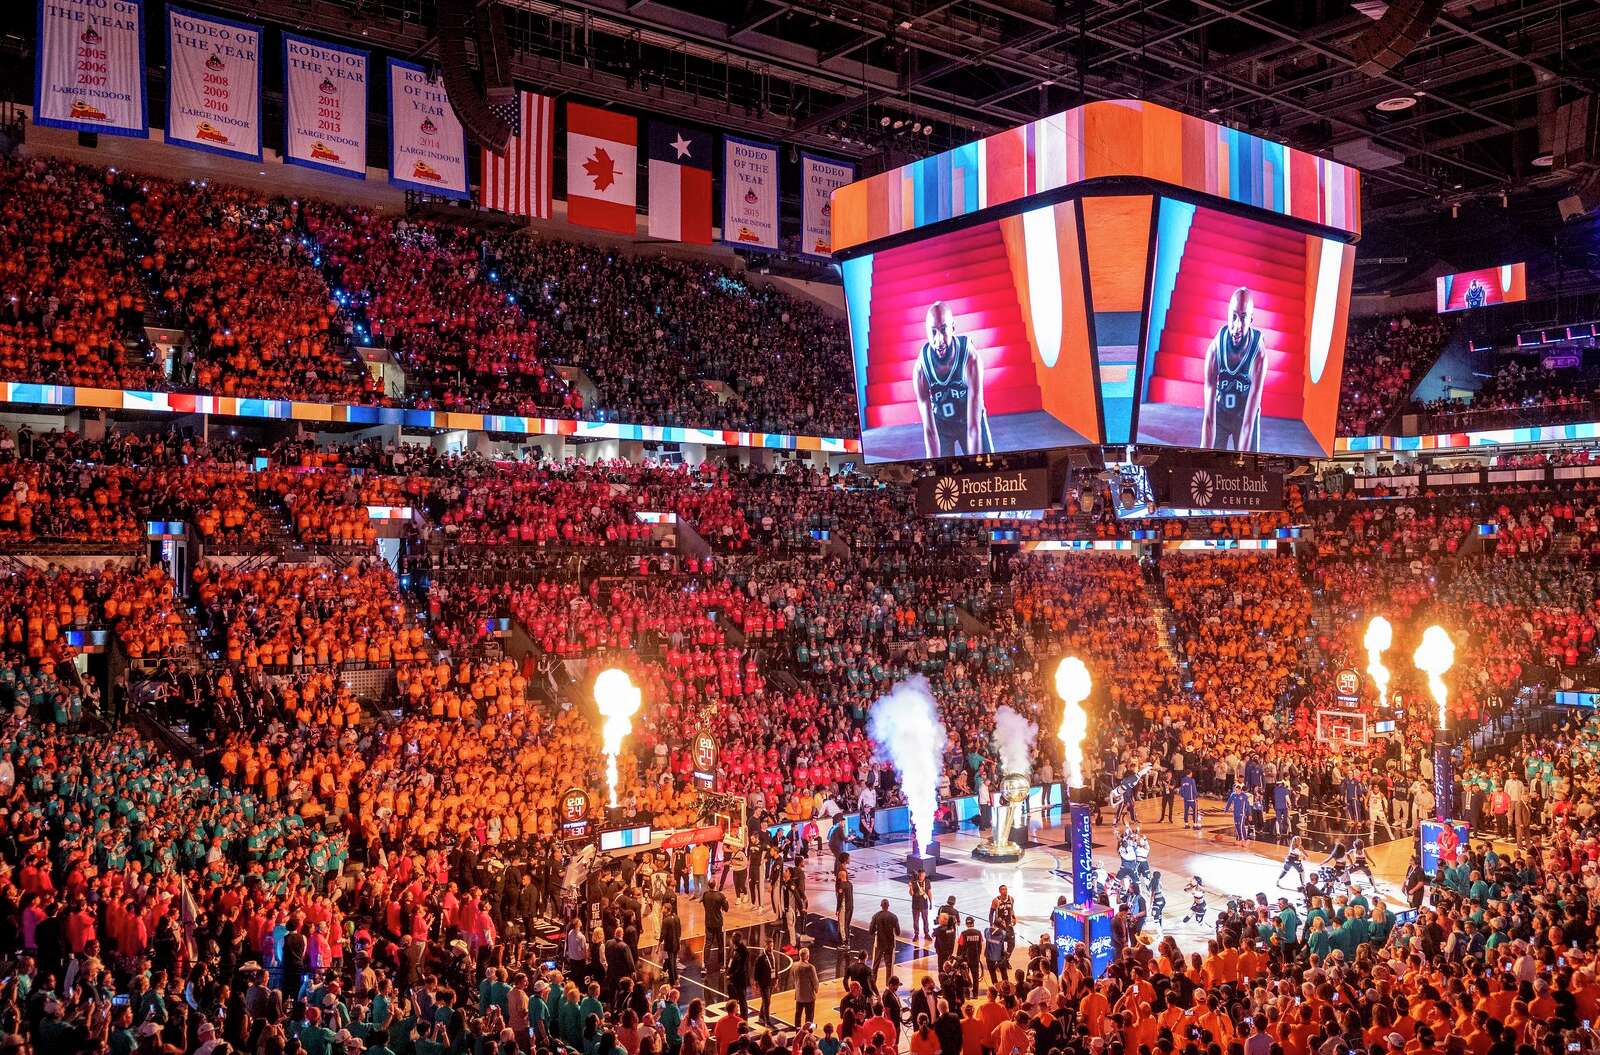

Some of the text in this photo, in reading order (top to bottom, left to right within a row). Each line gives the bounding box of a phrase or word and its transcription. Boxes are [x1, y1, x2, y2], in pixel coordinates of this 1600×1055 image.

[114, 2, 136, 15] OF
[48, 5, 135, 31] THE YEAR
[173, 17, 256, 45] RODEO OF
[78, 47, 107, 60] 2005
[175, 33, 255, 61] THE YEAR
[289, 43, 364, 68] RODEO OF
[78, 61, 107, 73] 2006
[290, 57, 364, 83] THE YEAR
[78, 74, 107, 86] 2007
[203, 72, 229, 87] 2008
[52, 84, 132, 102] LARGE INDOOR
[203, 85, 229, 99] 2009
[404, 84, 421, 97] OF
[204, 98, 229, 112] 2010
[318, 95, 340, 108] 2011
[412, 100, 444, 117] YEAR
[181, 106, 250, 129] LARGE INDOOR
[318, 107, 341, 121] 2012
[318, 120, 341, 133] 2013
[297, 128, 359, 148] LARGE INDOOR
[418, 136, 440, 149] 2014
[400, 144, 460, 164] LARGE INDOOR
[735, 146, 768, 161] RODEO
[733, 159, 769, 174] OF THE
[812, 162, 845, 178] RODEO
[738, 172, 765, 185] YEAR
[811, 175, 823, 185] OF
[961, 472, 1028, 494] Frost Bank
[1215, 474, 1269, 493] Frost Bank
[969, 497, 1017, 507] CENTER
[1222, 496, 1260, 505] CENTER
[567, 805, 582, 818] 24
